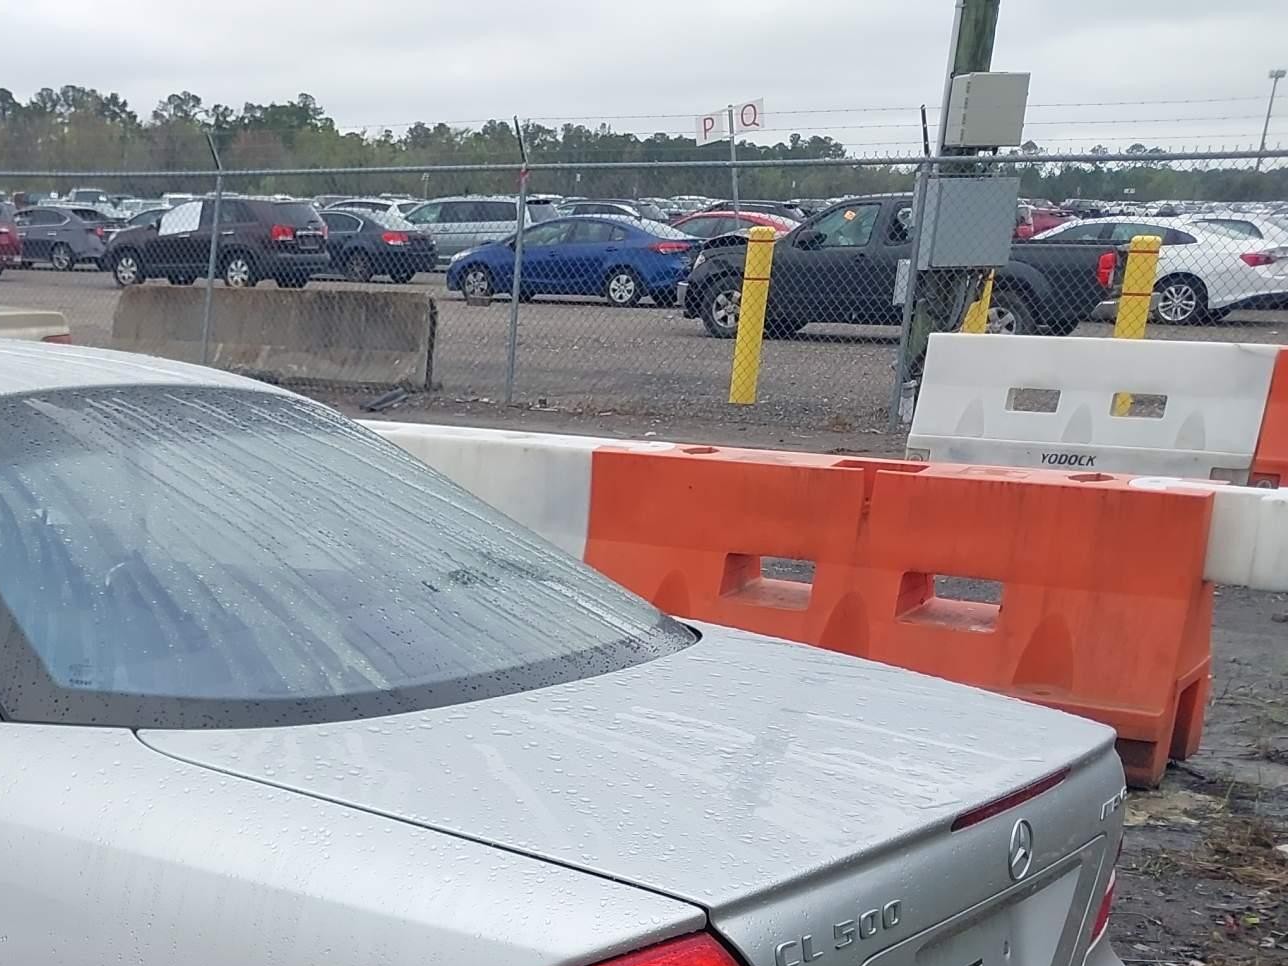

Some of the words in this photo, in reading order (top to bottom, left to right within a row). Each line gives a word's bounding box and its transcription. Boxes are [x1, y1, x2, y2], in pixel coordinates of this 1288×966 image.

[740, 103, 760, 127] Q
[703, 117, 715, 140] P
[1041, 453, 1097, 467] YODOCK
[833, 899, 902, 950] 500
